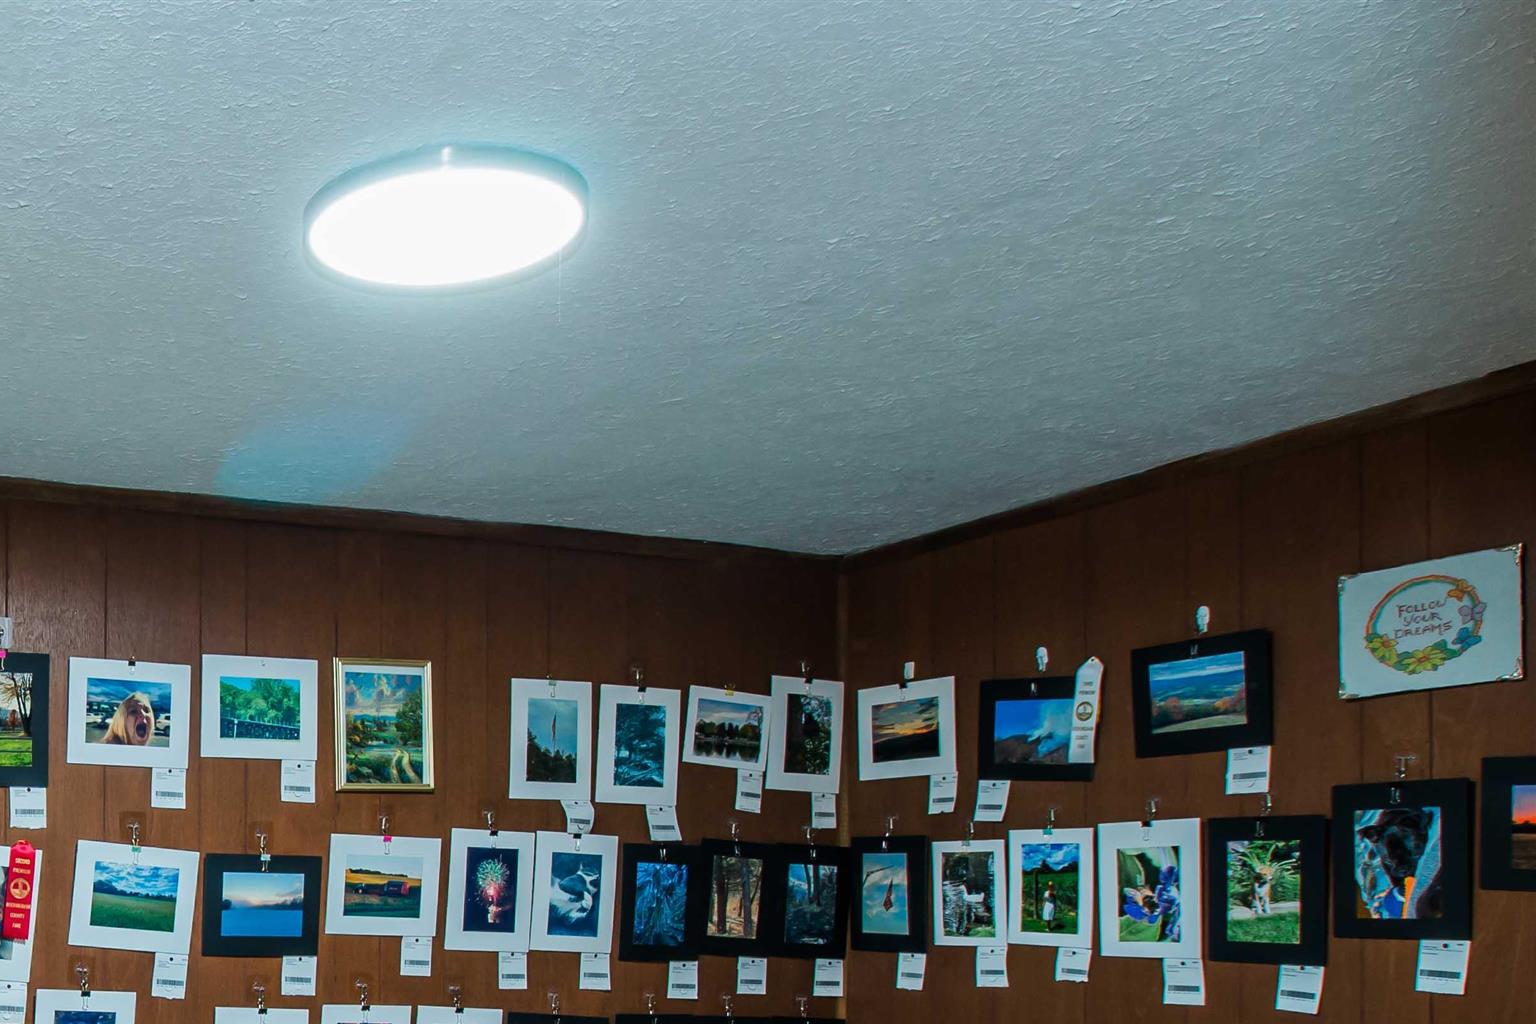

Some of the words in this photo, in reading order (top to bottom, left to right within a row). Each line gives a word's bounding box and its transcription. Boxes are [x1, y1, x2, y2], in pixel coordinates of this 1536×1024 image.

[1395, 597, 1448, 618] FOLLOW
[1403, 612, 1443, 627] YOUR
[1394, 620, 1453, 639] DREAMS
